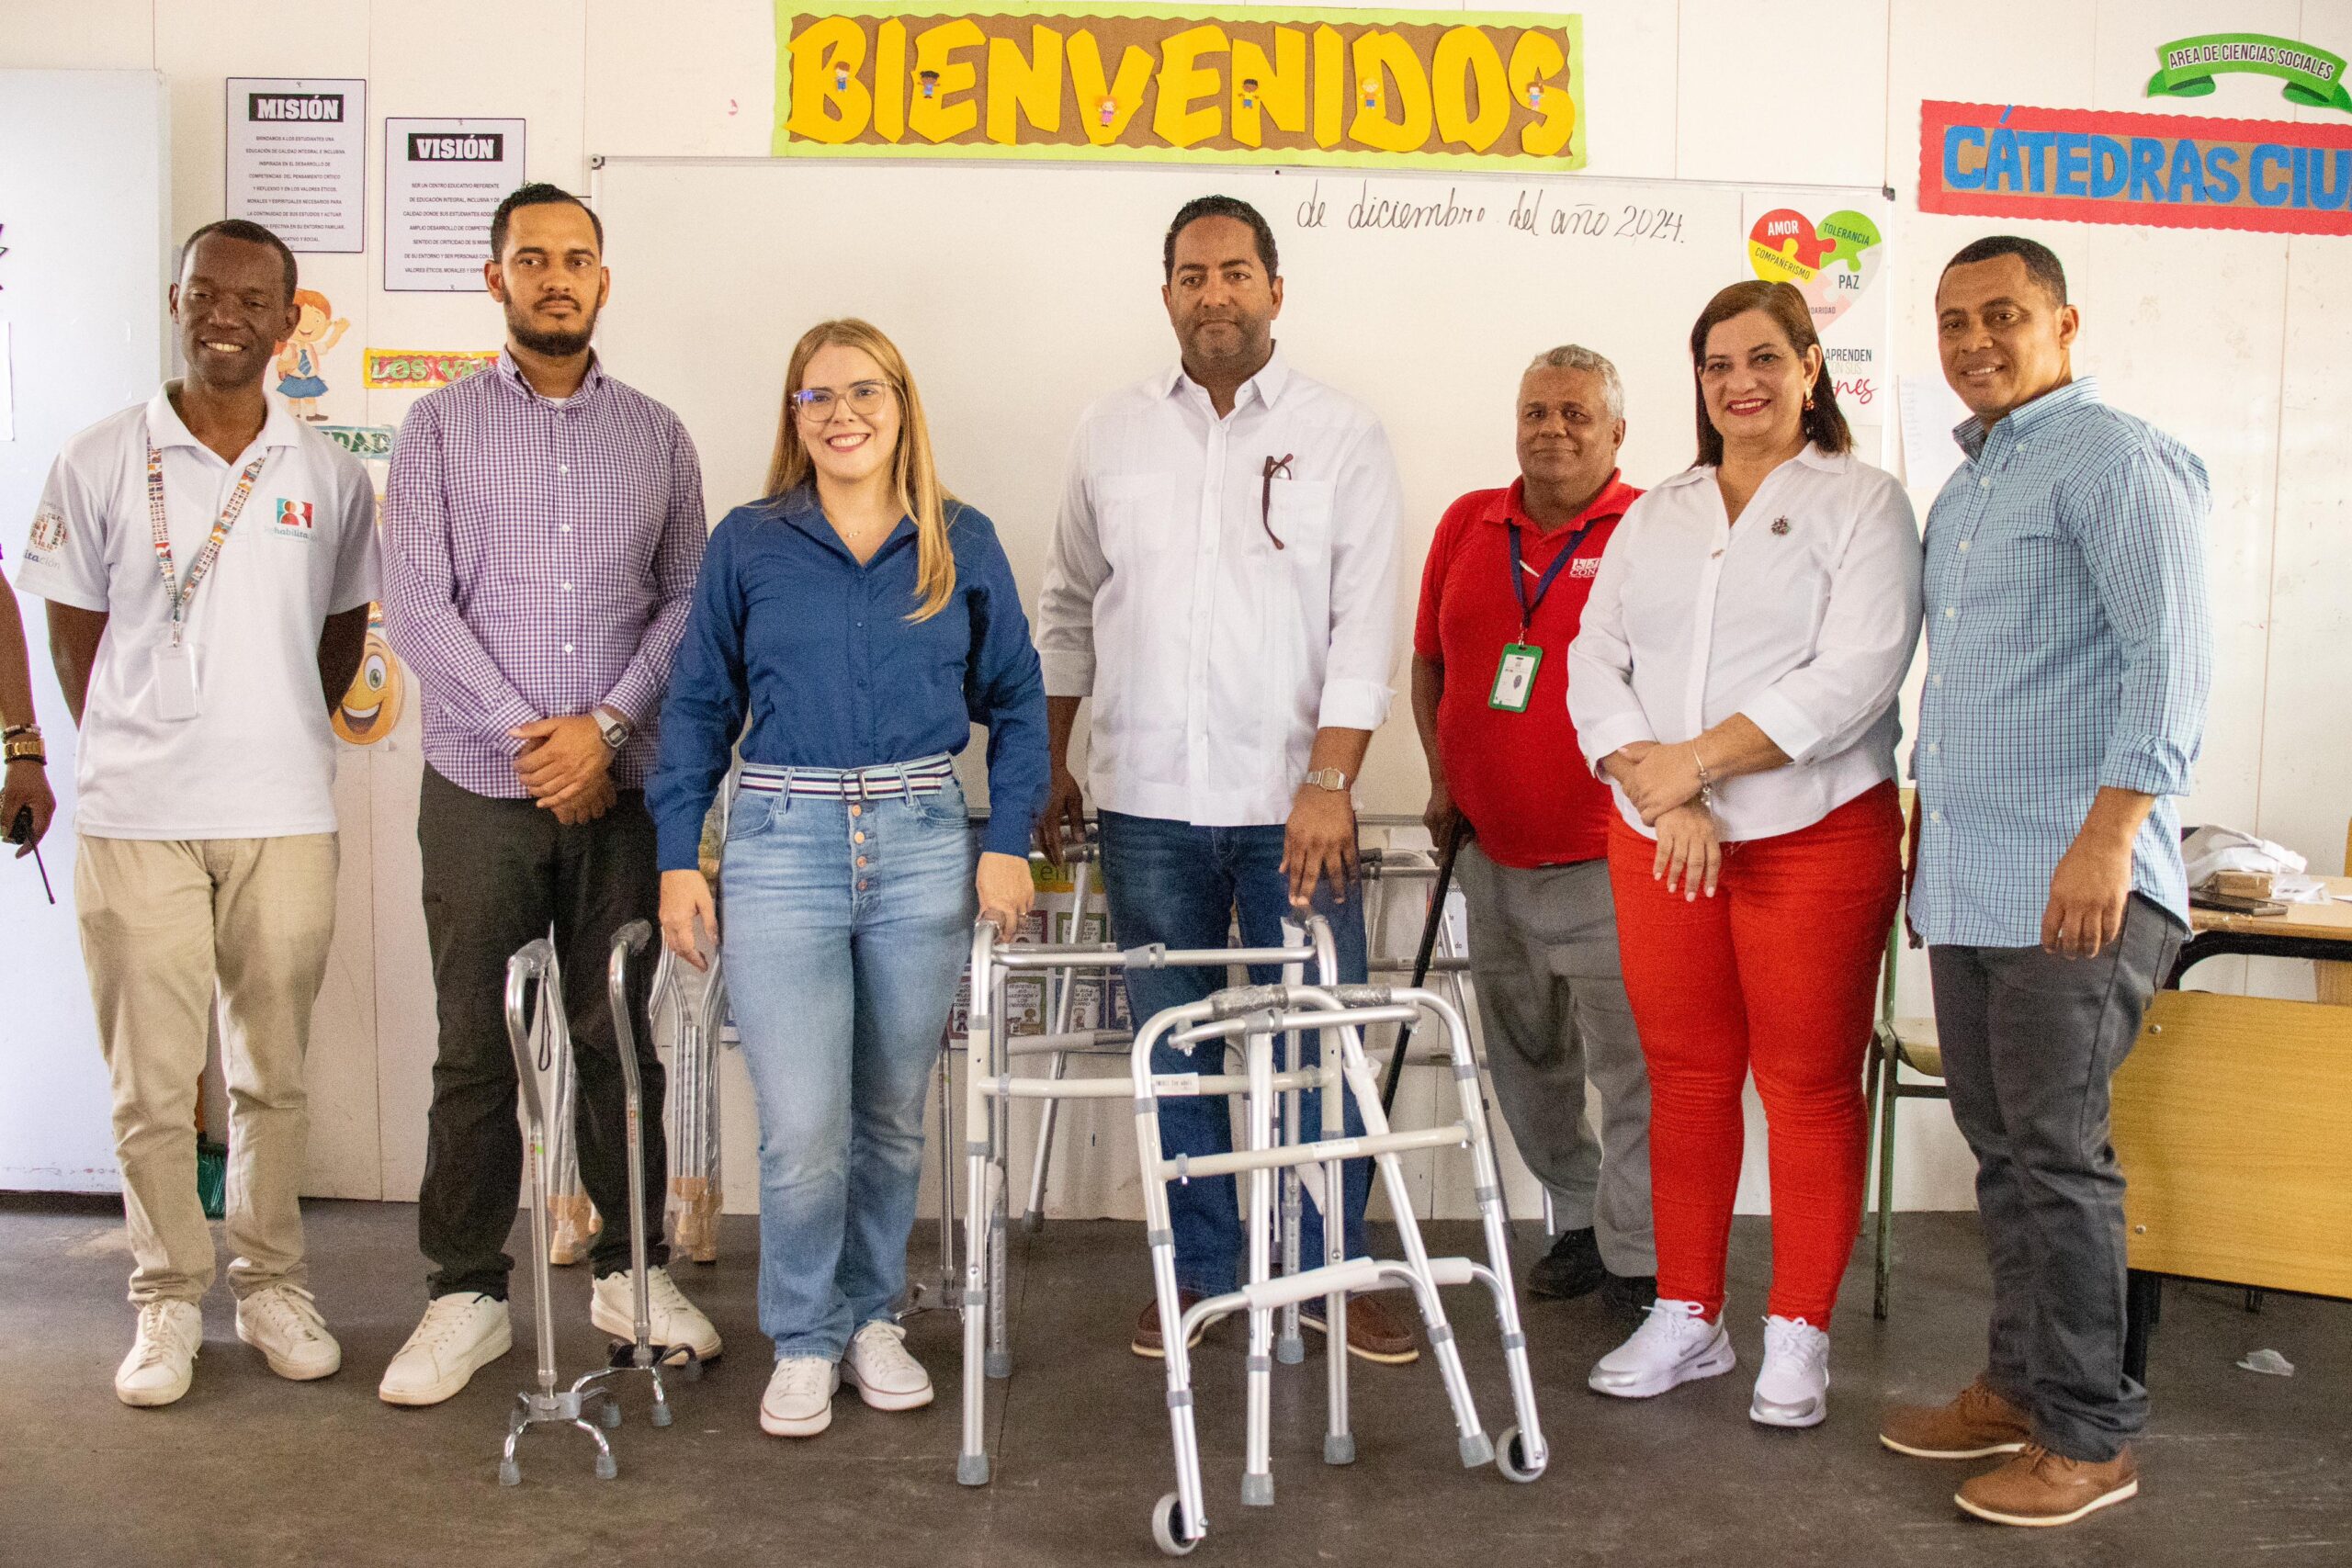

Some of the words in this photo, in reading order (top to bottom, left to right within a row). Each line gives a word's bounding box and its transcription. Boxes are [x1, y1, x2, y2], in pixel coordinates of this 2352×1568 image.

[2168, 46, 2201, 70] AREA
[2202, 44, 2220, 62] DE
[2221, 42, 2275, 64] CIENCIAS
[2277, 47, 2335, 81] SOCIALES
[785, 17, 1576, 155] BIENVENIDOS
[257, 95, 339, 120] MISIÓN
[416, 134, 494, 160] VISIÓN
[1943, 104, 2240, 205] CÁTEDRAS
[2249, 143, 2352, 212] CIU
[1296, 178, 1329, 228] de
[1508, 189, 1539, 237] del
[1551, 203, 1610, 236] año
[1768, 220, 1800, 237] AMOR
[1823, 222, 1871, 246] TOLERANCIA
[1754, 247, 1812, 280] COMPAÑERISMO
[1838, 275, 1860, 290] PAZ
[1825, 348, 1872, 362] APRENDEN
[371, 357, 428, 380] LOS
